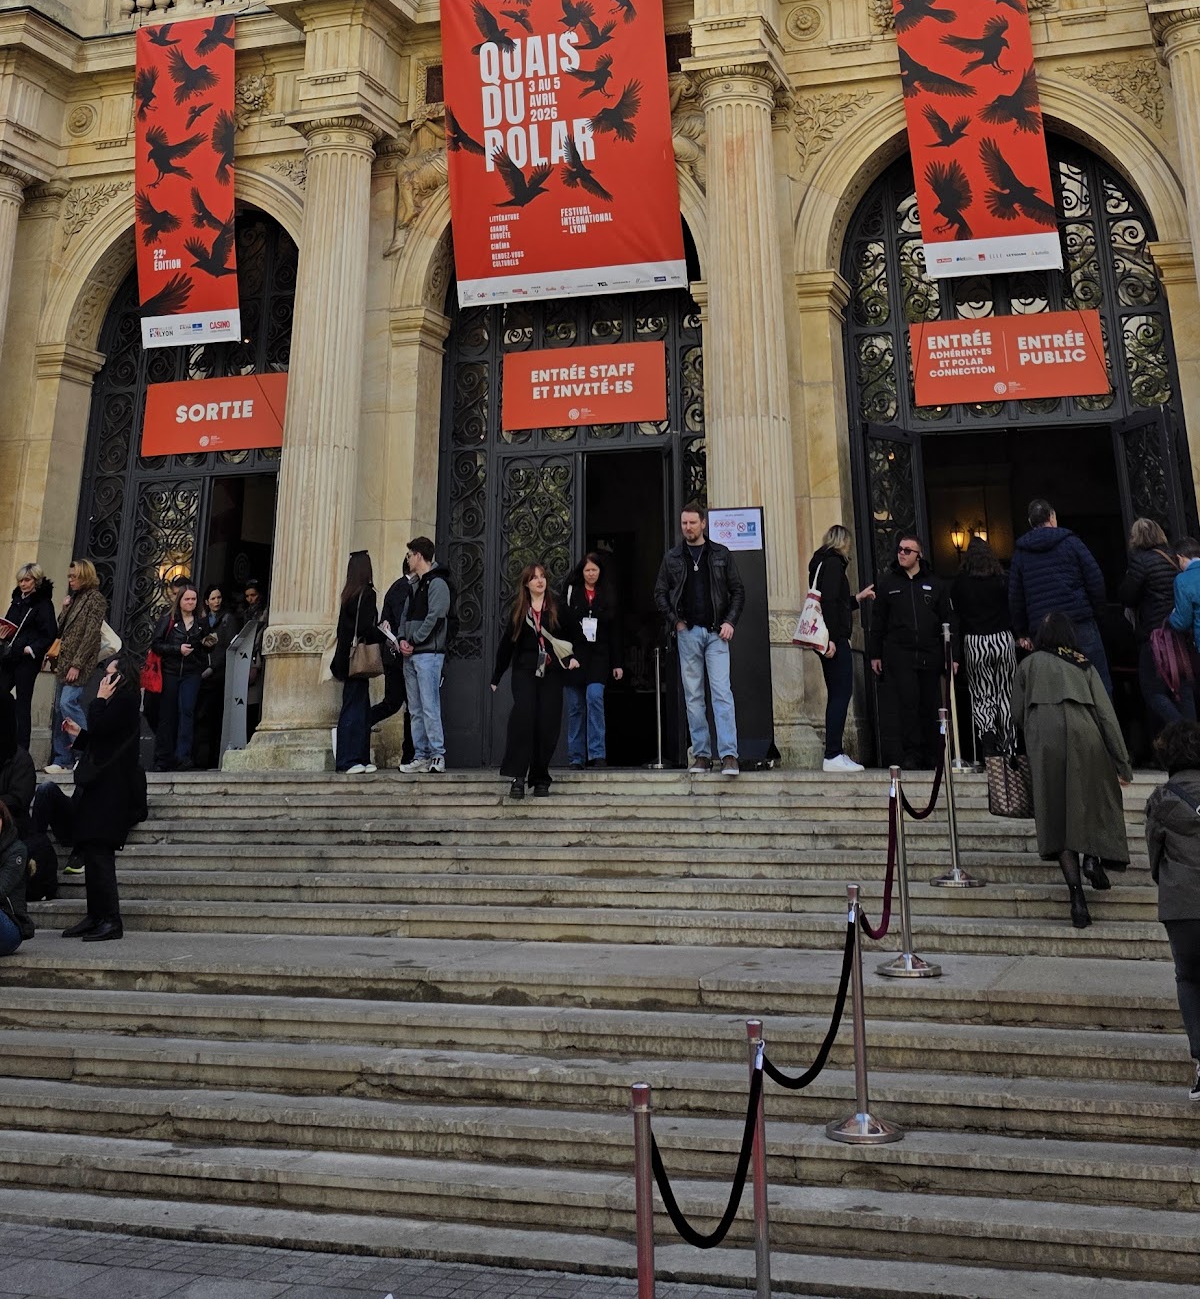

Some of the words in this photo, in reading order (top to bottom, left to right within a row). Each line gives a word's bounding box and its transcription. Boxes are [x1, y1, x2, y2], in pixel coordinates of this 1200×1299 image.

[480, 30, 580, 86] QUAIS
[528, 80, 536, 92] 3
[538, 78, 551, 92] AU
[553, 76, 560, 90] 5
[482, 82, 526, 128] DU
[530, 92, 558, 108] AVRIL
[530, 106, 558, 122] 2026
[484, 118, 596, 172] POLAR
[489, 213, 520, 222] LITTÉRATURE
[560, 206, 592, 217] FESTIVAL
[561, 212, 613, 226] INTERNATIONAL
[490, 224, 508, 232] GRANDE
[570, 224, 586, 234] LYON
[490, 231, 511, 240] ENQUÊTE
[490, 242, 510, 250] CINÉMA
[492, 251, 524, 260] RENDEZ-VOUS
[154, 258, 182, 271] ÉDITION
[492, 258, 519, 268] CULTURELS
[210, 320, 230, 330] CASINO
[928, 329, 992, 350] ENTRÉE
[1017, 330, 1086, 350] ENTRÉE
[939, 359, 950, 368] ET
[952, 358, 984, 367] POLAR
[1019, 348, 1087, 366] PUBLIC
[530, 364, 586, 384] ENTRÉE
[590, 362, 636, 378] STAFF
[929, 366, 996, 378] CONNECTION
[532, 386, 550, 400] ET
[176, 400, 254, 424] SORTIE
